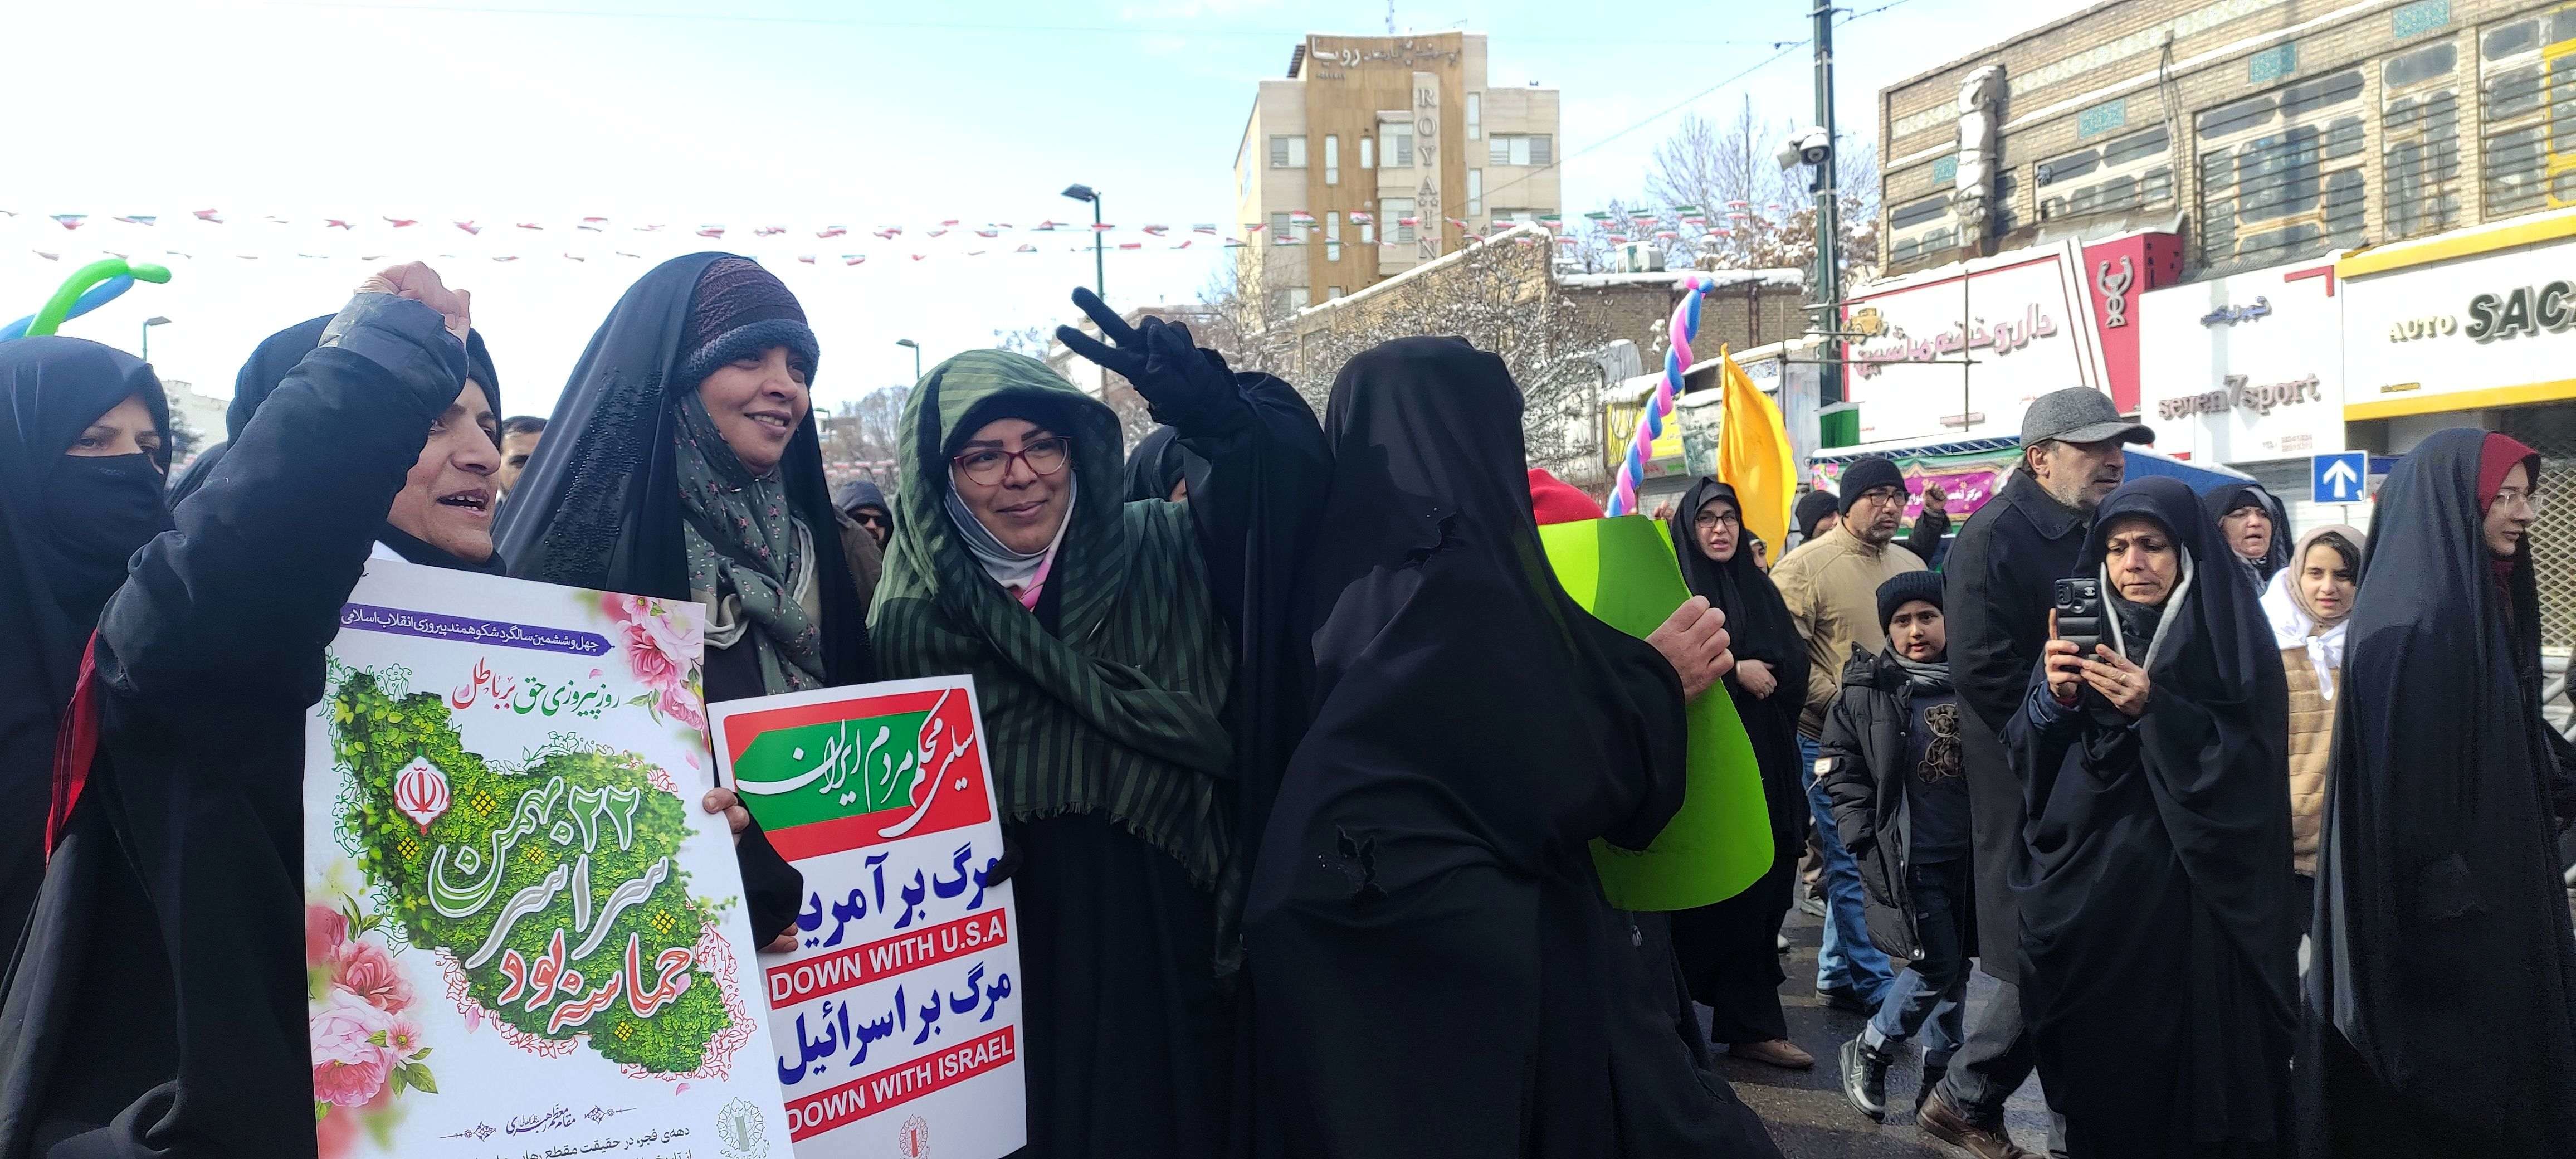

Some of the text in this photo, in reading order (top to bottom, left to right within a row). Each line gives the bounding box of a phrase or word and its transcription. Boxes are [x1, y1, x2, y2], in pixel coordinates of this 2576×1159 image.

[1935, 303, 2057, 357] داروخانه
[2389, 280, 2576, 345] AUTO SAC
[341, 608, 599, 652] چهل و ششمین سالگرد شکوهمند پیروزی انقلاب اسلامی
[513, 676, 547, 714] حق
[541, 680, 601, 720] پیروزی
[594, 683, 620, 709] روز
[735, 687, 975, 838] سیلی محکم مردم ایران
[428, 775, 640, 918] ۲۲ بهمن
[465, 853, 669, 970] سراسر
[795, 841, 1001, 949] مرگ بر آمری
[498, 928, 693, 1035] حماسه بود
[770, 915, 1005, 1002] DOWN WITH U.S.A
[777, 960, 1012, 1085] مرگ بر اسرائیل
[786, 1034, 1014, 1134] DOWN WITH ISRAEL
[506, 1103, 576, 1137] مقام معظم رهبری
[580, 1138, 621, 1153] حقیقت
[624, 1137, 634, 1150] در
[545, 1145, 578, 1158] مقطع
